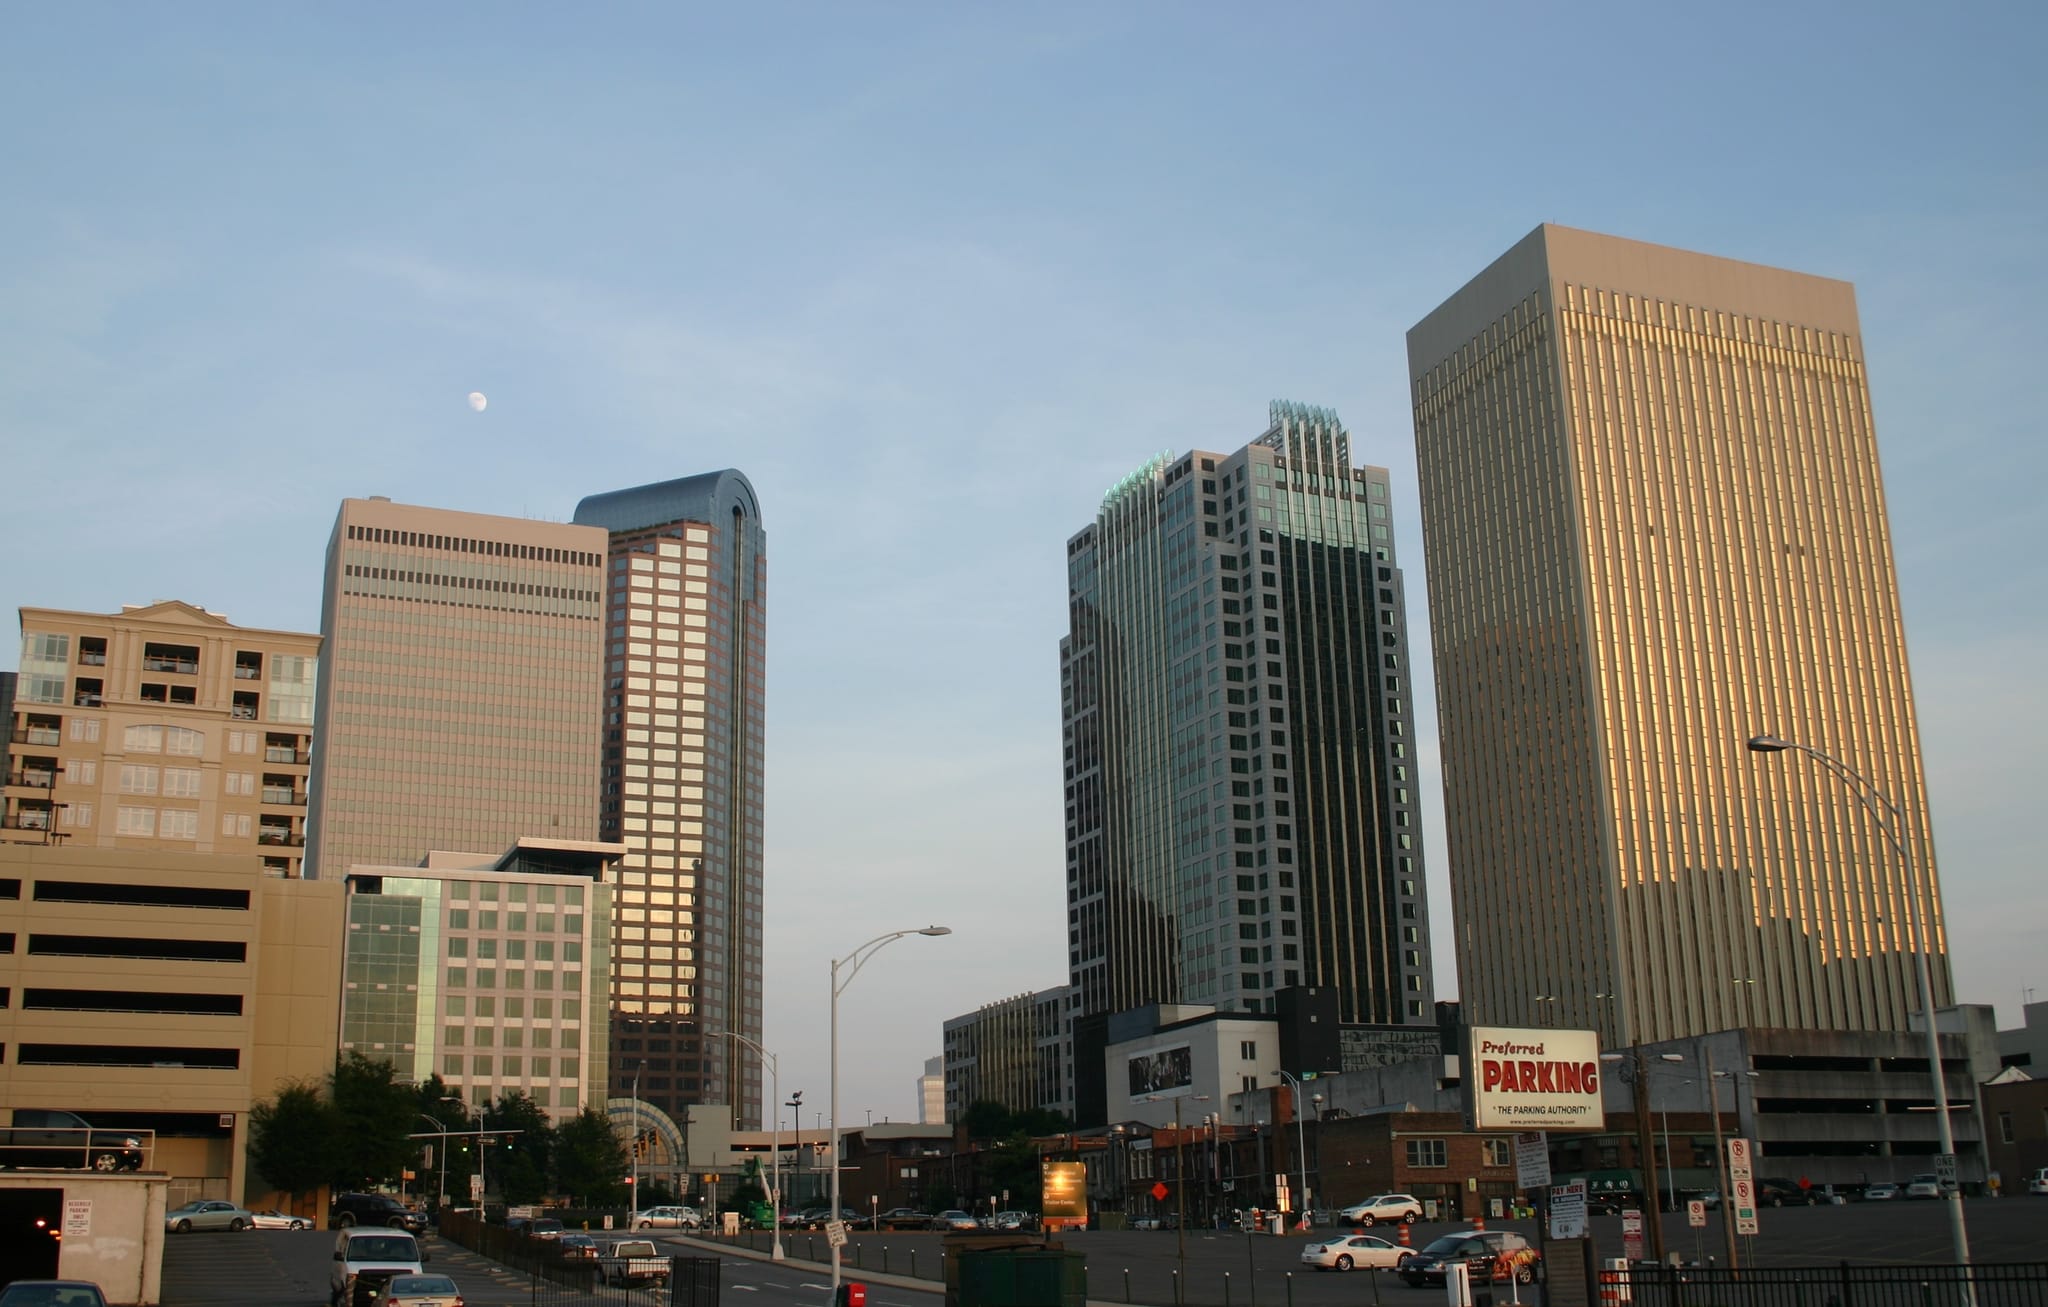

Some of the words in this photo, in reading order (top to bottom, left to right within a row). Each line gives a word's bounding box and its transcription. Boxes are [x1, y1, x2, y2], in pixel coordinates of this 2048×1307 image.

[1481, 1041, 1544, 1056] Preferred
[1482, 1060, 1598, 1095] PARKING
[1513, 1105, 1546, 1114] PARKING
[1936, 1157, 1953, 1166] ONE
[1937, 1167, 1955, 1176] WAY
[1552, 1187, 1564, 1195] PAY
[1567, 1184, 1584, 1194] HERE
